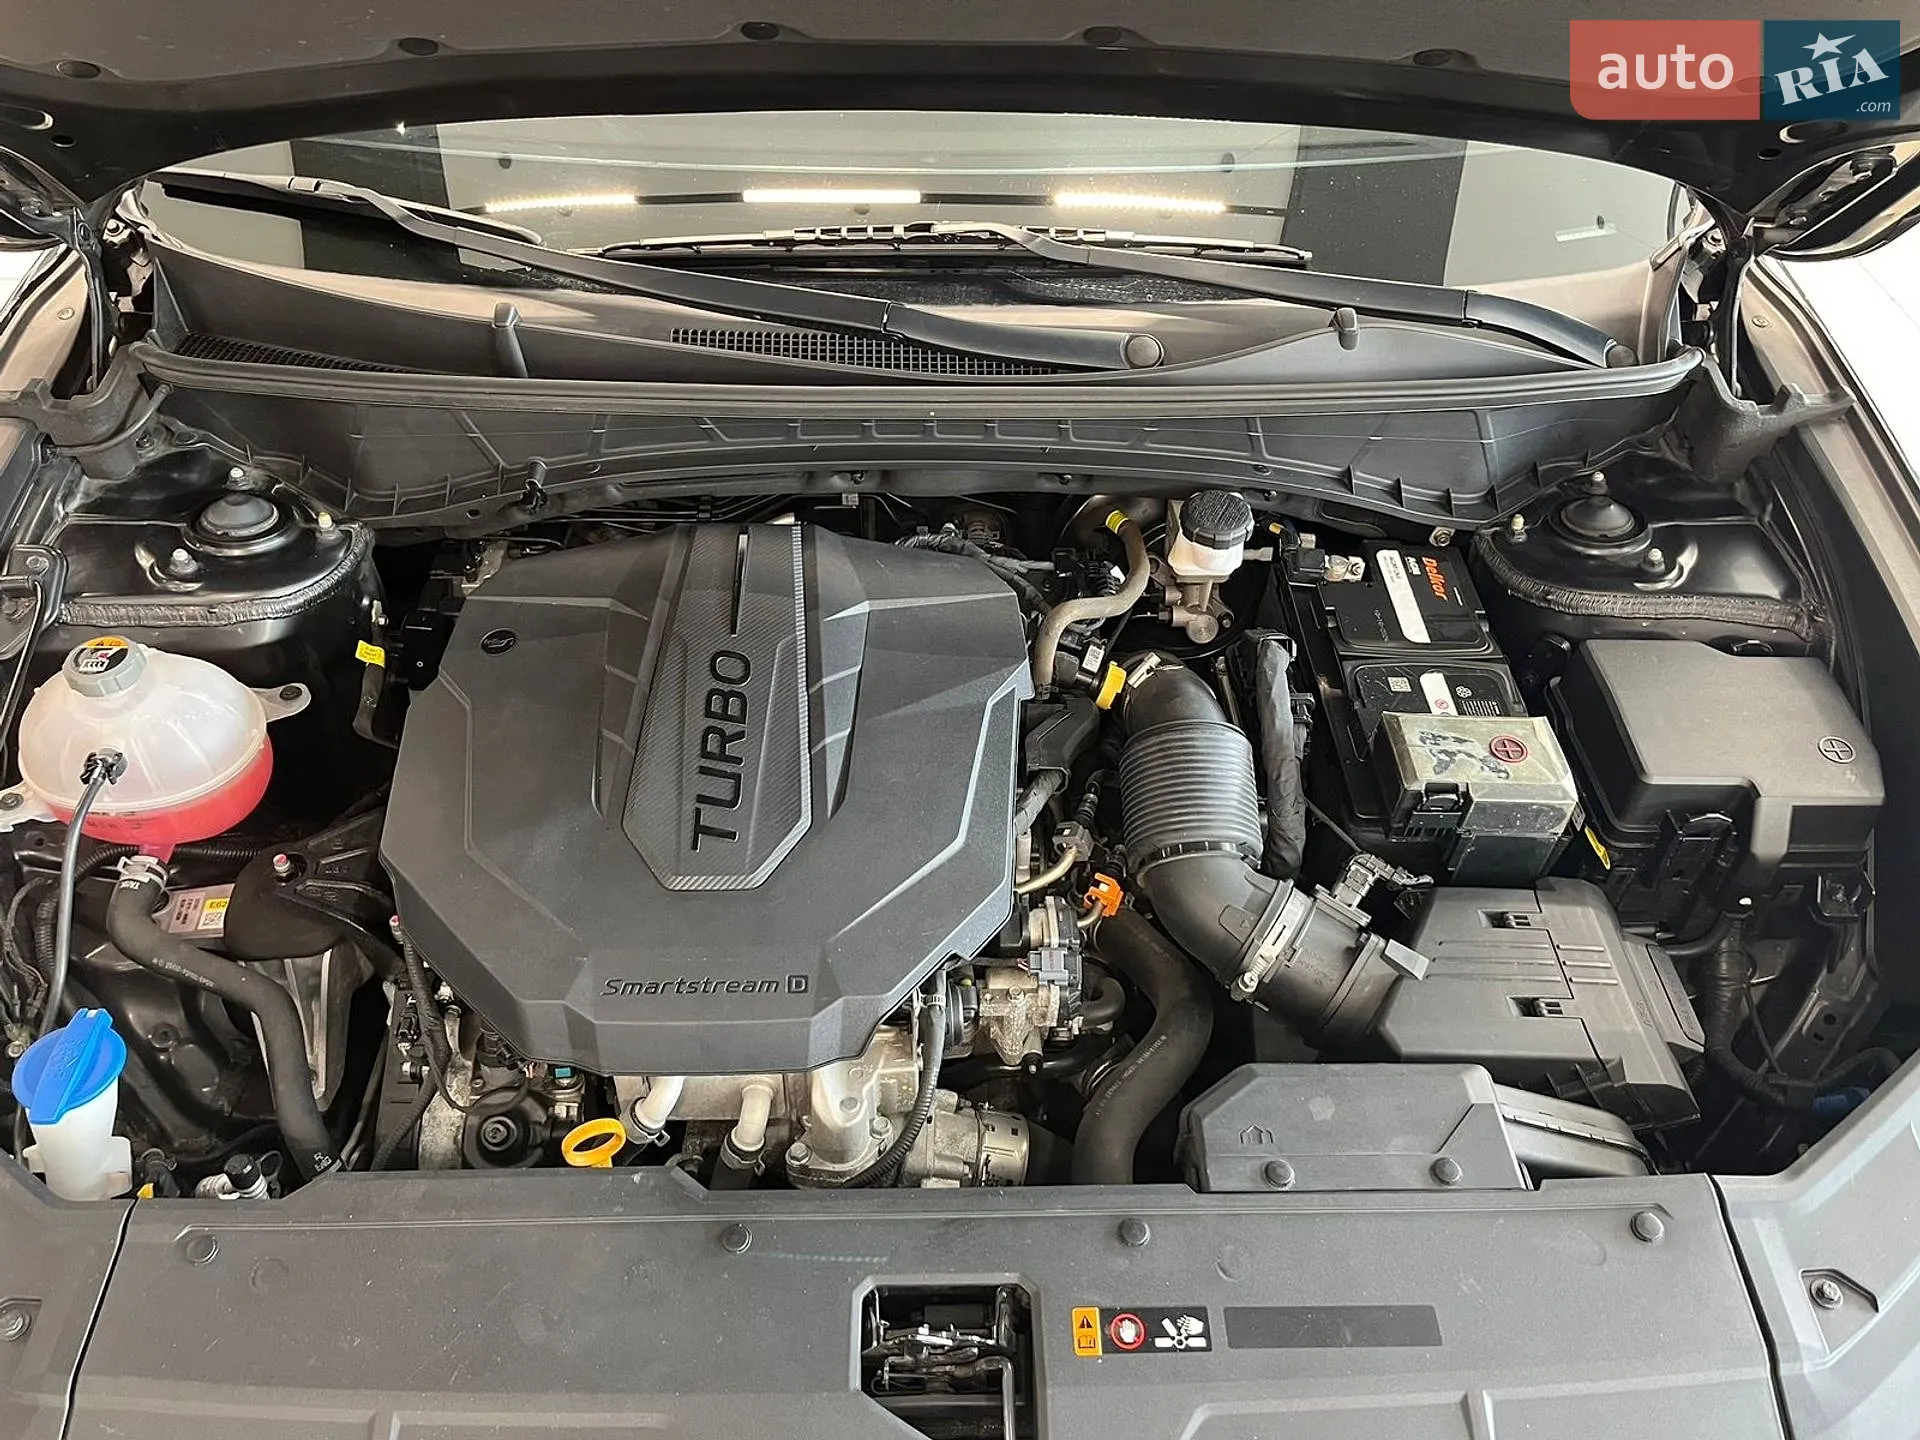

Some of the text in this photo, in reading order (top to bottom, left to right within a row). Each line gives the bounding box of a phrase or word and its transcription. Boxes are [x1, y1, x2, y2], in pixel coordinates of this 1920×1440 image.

[1421, 556, 1448, 601] Delkor
[692, 649, 752, 853] TURBO
[601, 974, 809, 996] Smartstream D
